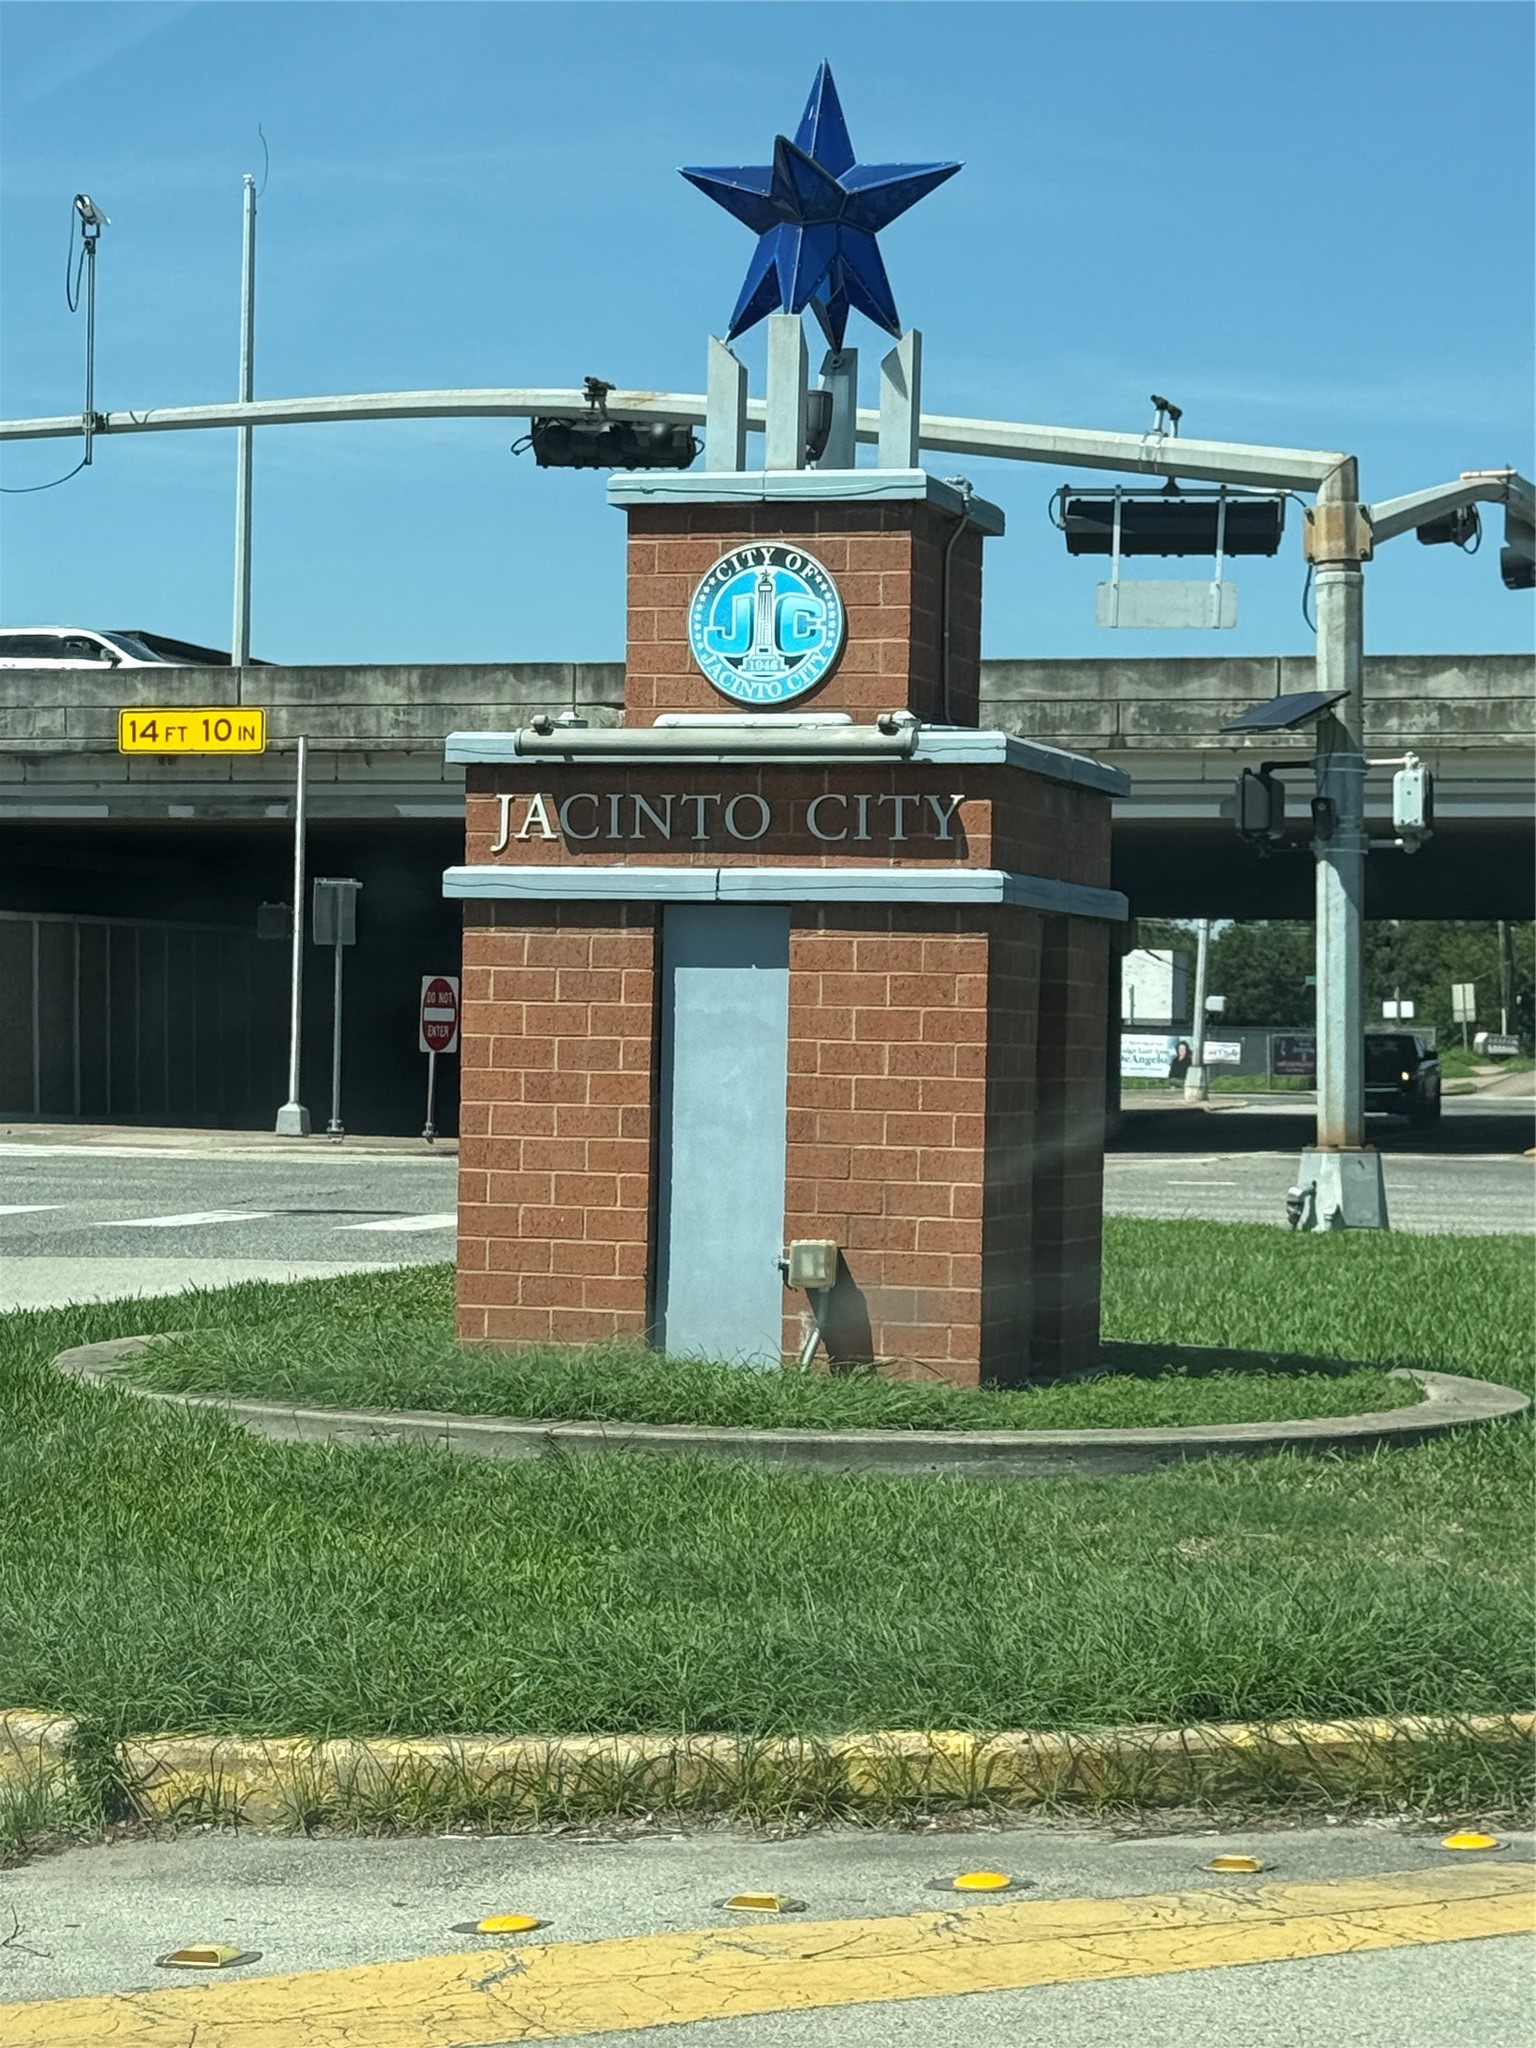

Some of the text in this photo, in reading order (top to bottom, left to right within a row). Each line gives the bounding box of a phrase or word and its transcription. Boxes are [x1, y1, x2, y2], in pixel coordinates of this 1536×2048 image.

[715, 547, 818, 581] CITY OF
[700, 651, 829, 698] JACINTO CITY
[748, 659, 779, 671] 1946
[129, 718, 255, 742] 14 FT 10 IN
[491, 793, 966, 853] JACINTO CITY
[427, 992, 453, 1004] DO NOT
[428, 1025, 449, 1038] ENTER
